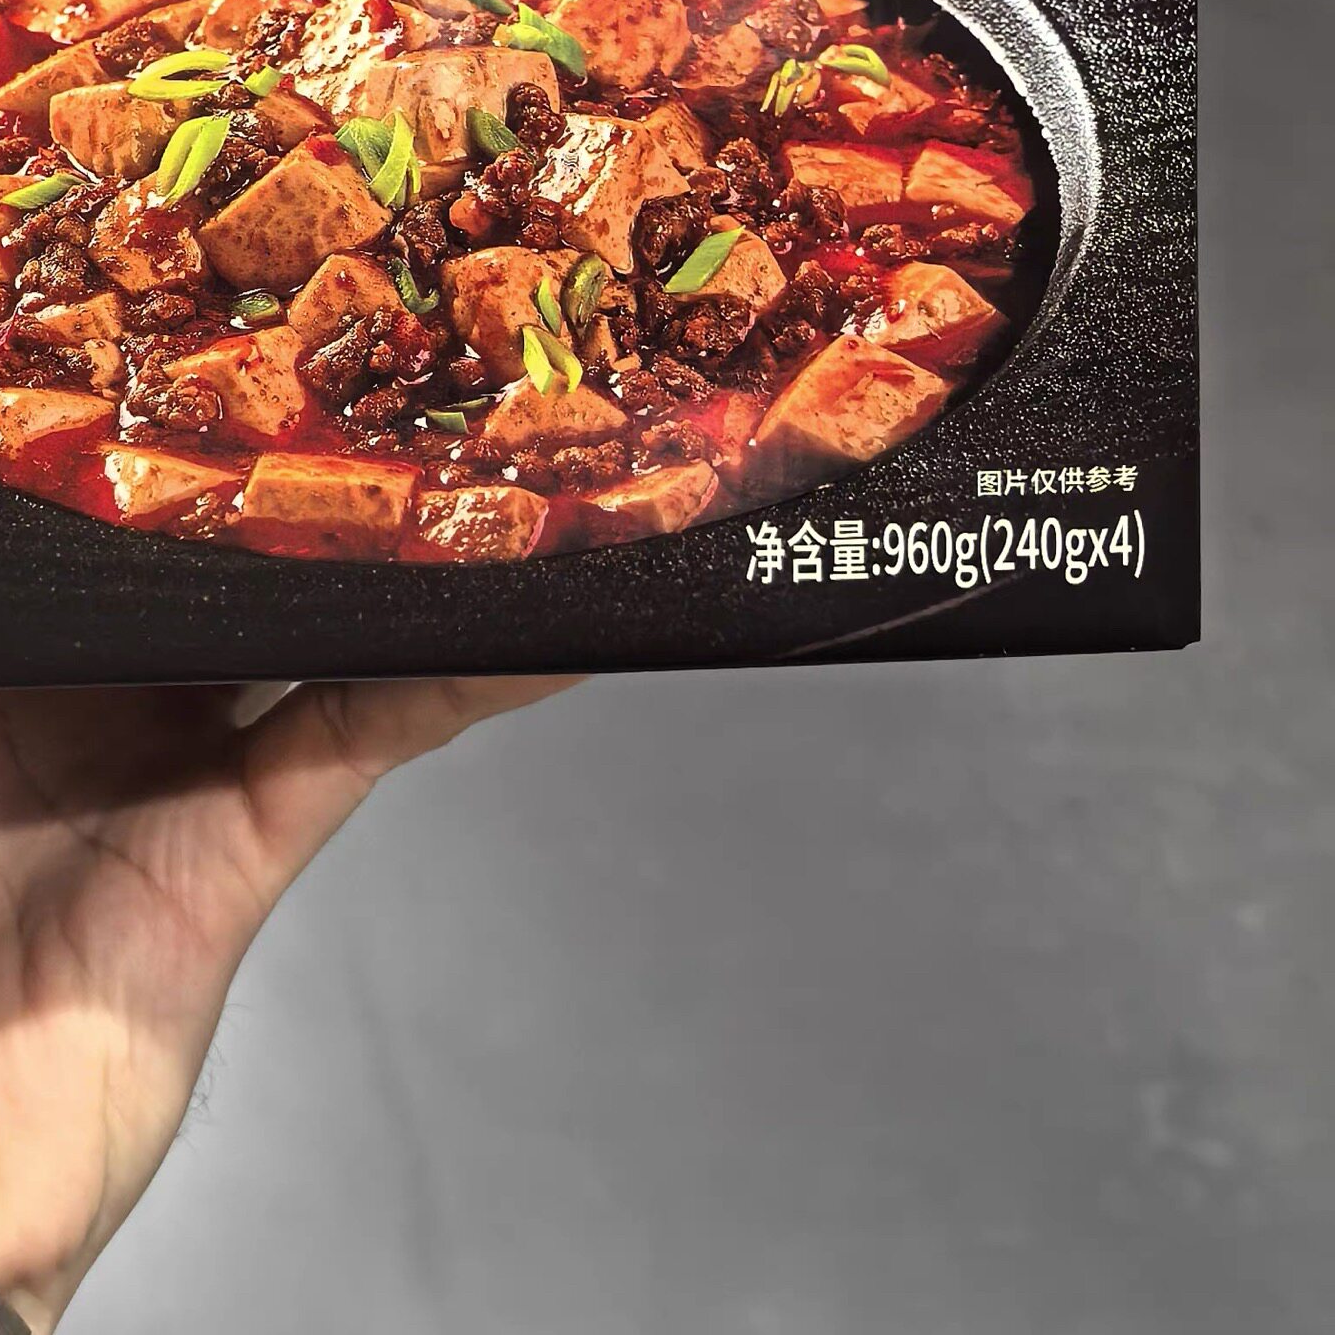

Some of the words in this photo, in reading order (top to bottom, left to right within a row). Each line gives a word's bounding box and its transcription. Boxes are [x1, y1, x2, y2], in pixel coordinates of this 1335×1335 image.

[976, 465, 1139, 497] 图片仅供参考
